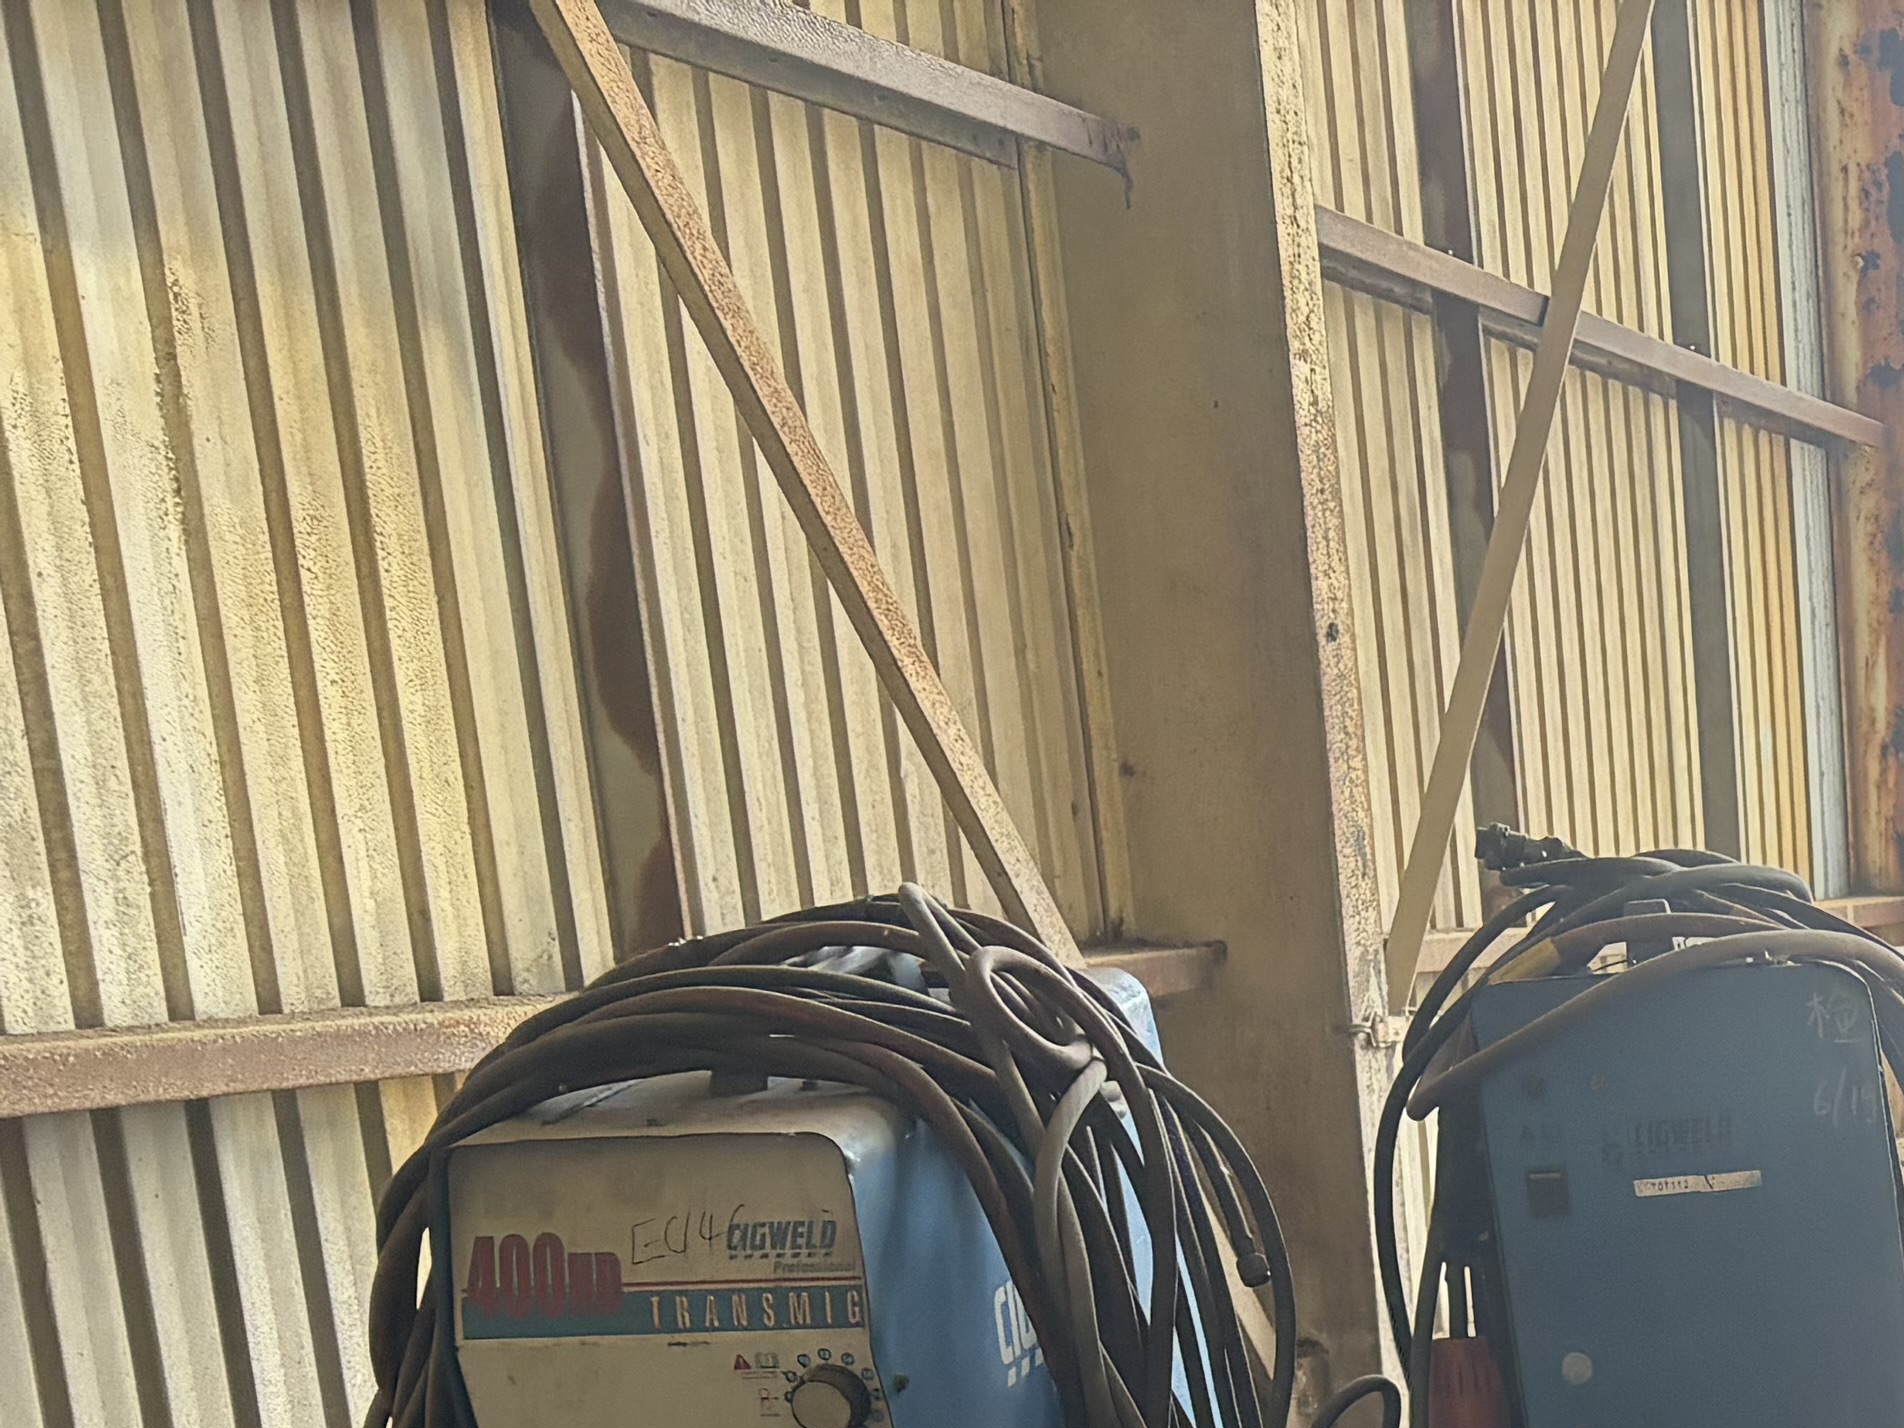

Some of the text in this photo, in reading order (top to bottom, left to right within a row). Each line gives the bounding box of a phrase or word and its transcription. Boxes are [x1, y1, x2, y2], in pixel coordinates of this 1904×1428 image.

[726, 1219, 837, 1252] CIGWELD
[467, 1231, 624, 1319] 400HD
[650, 1293, 862, 1329] TRANSMIG
